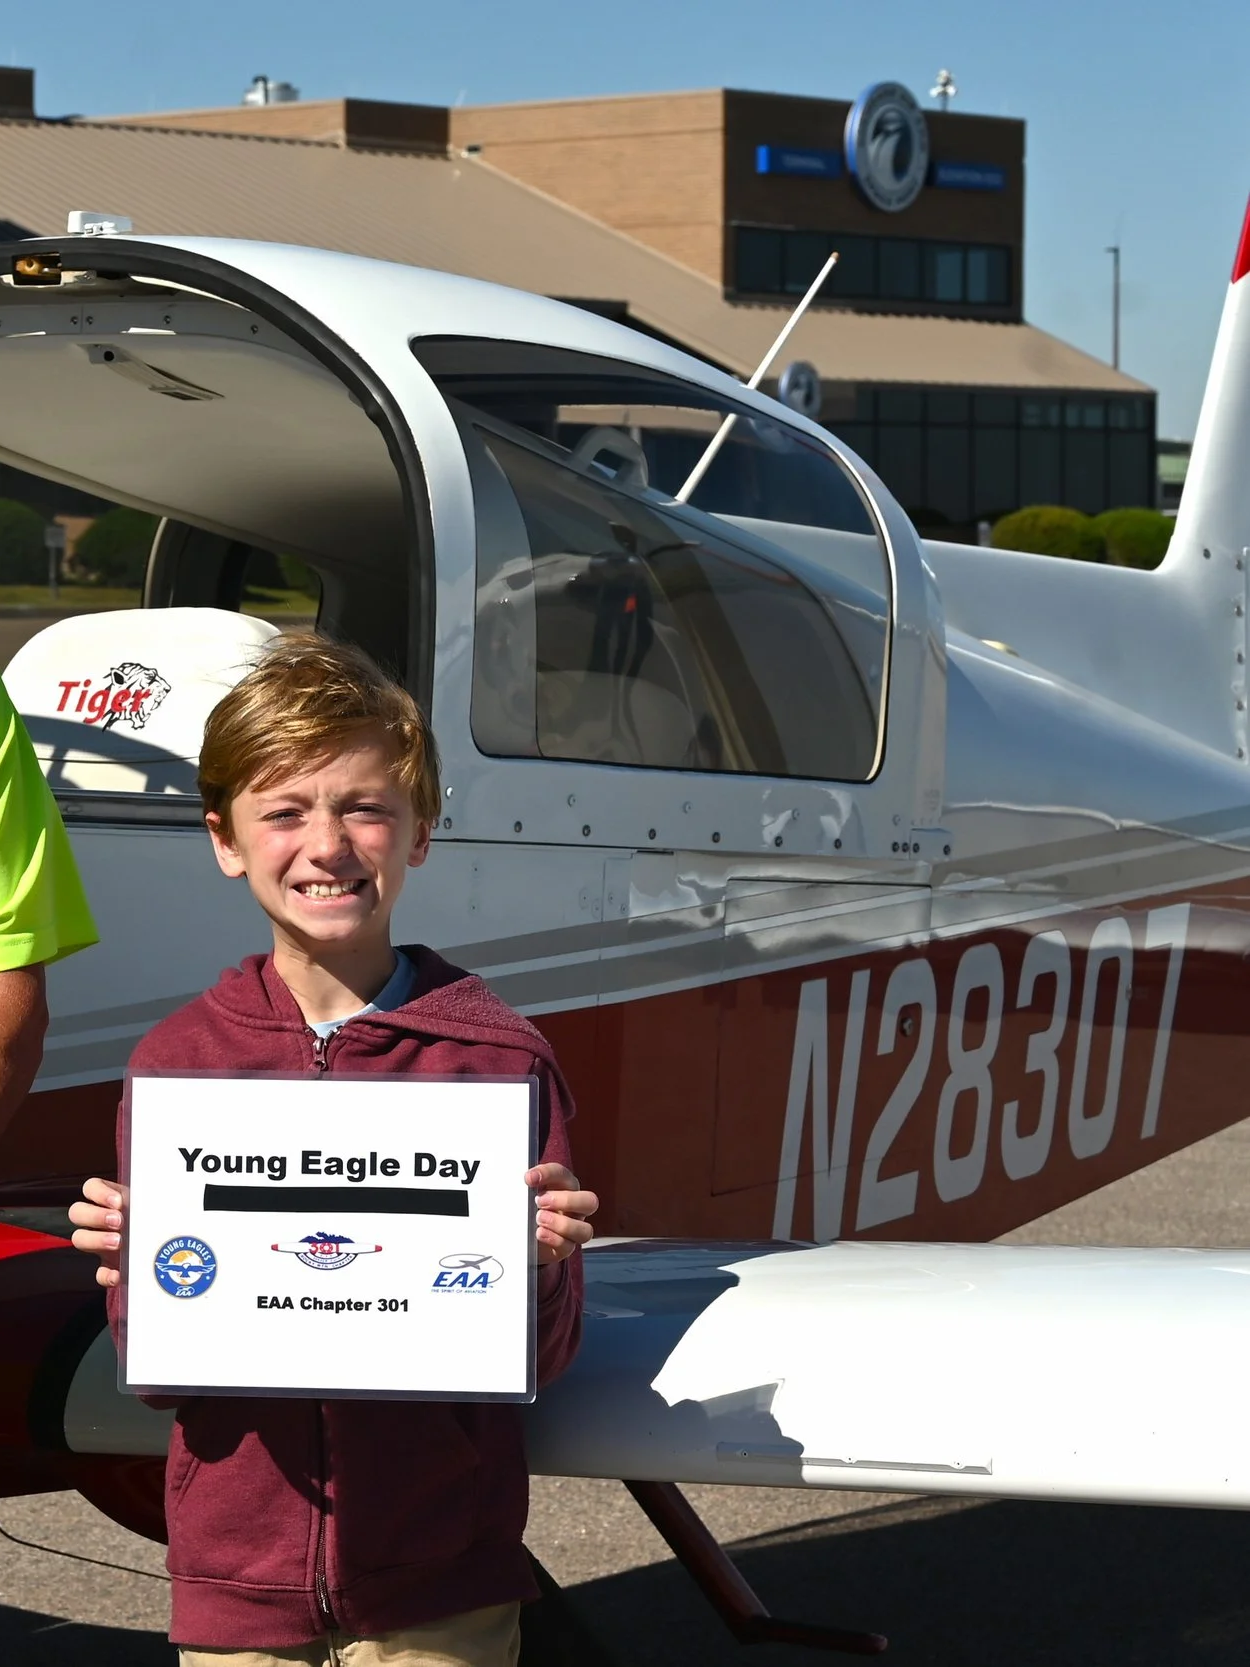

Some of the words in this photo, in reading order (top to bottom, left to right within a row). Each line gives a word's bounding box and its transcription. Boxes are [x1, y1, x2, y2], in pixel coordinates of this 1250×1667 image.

[56, 679, 152, 724] Tiger
[772, 902, 1191, 1244] N28307
[178, 1147, 287, 1181] Young
[301, 1150, 401, 1182] Eagle
[414, 1152, 481, 1185] Day
[159, 1239, 185, 1260] YOUNG
[187, 1239, 212, 1261] EAGLES
[432, 1271, 489, 1288] EAA
[257, 1296, 294, 1309] EAA
[300, 1297, 372, 1314] Chapter
[377, 1298, 408, 1312] 301
